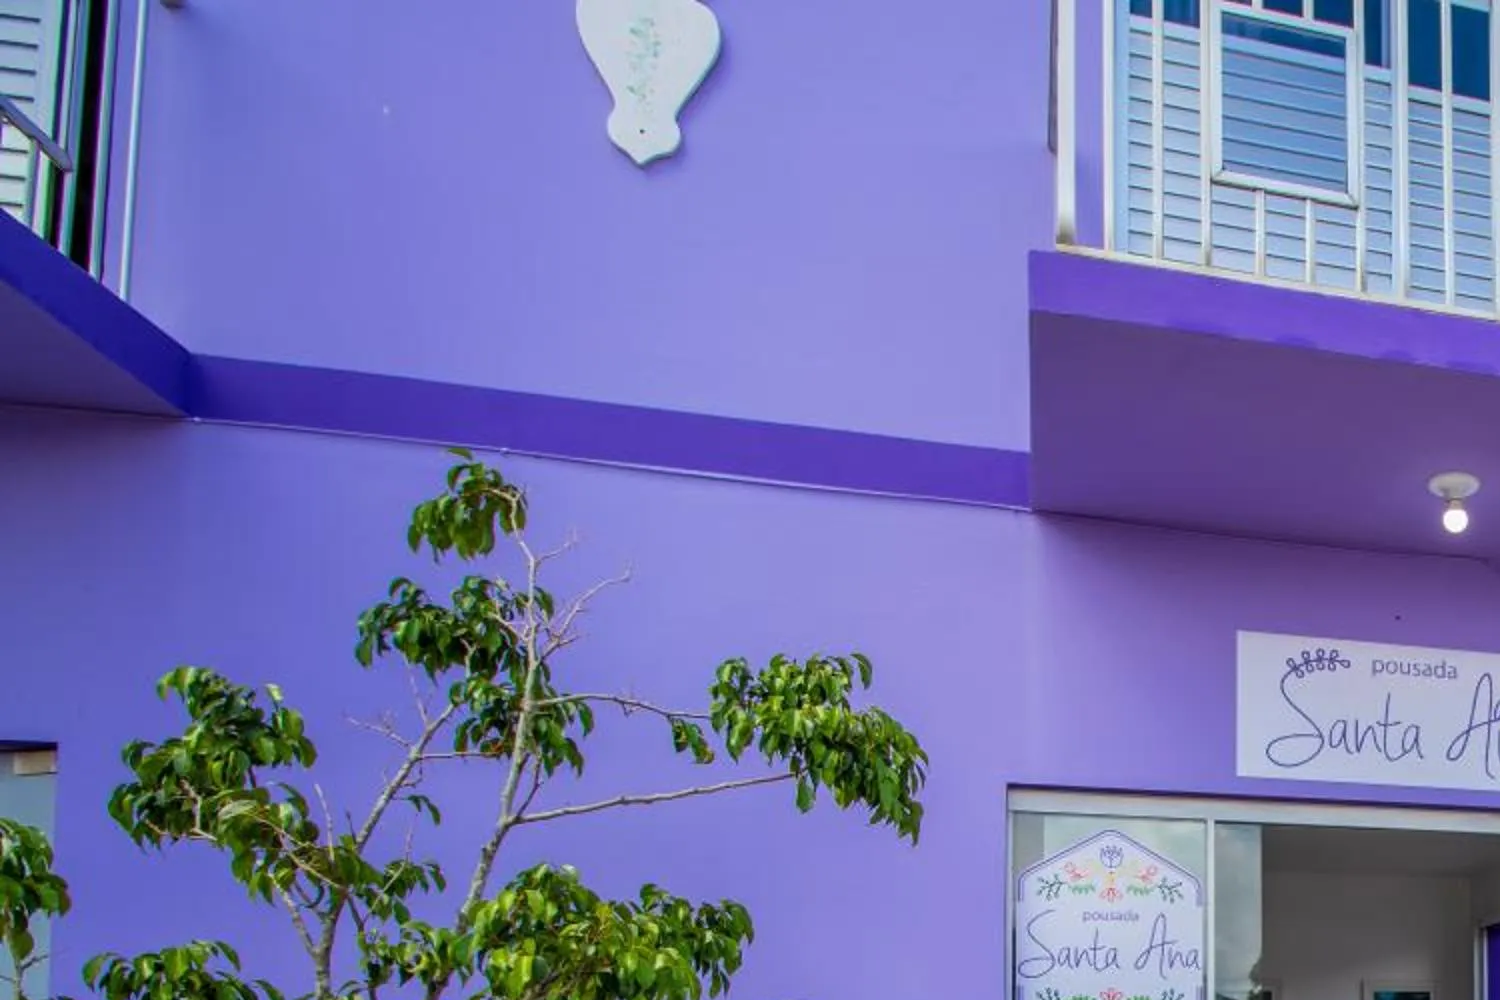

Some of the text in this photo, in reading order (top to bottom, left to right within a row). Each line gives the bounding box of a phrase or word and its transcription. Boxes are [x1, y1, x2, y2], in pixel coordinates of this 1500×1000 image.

[1371, 658, 1458, 680] pousada
[1266, 658, 1425, 768] Santa
[1082, 909, 1140, 923] pousada
[1017, 908, 1203, 980] Santa Ana
